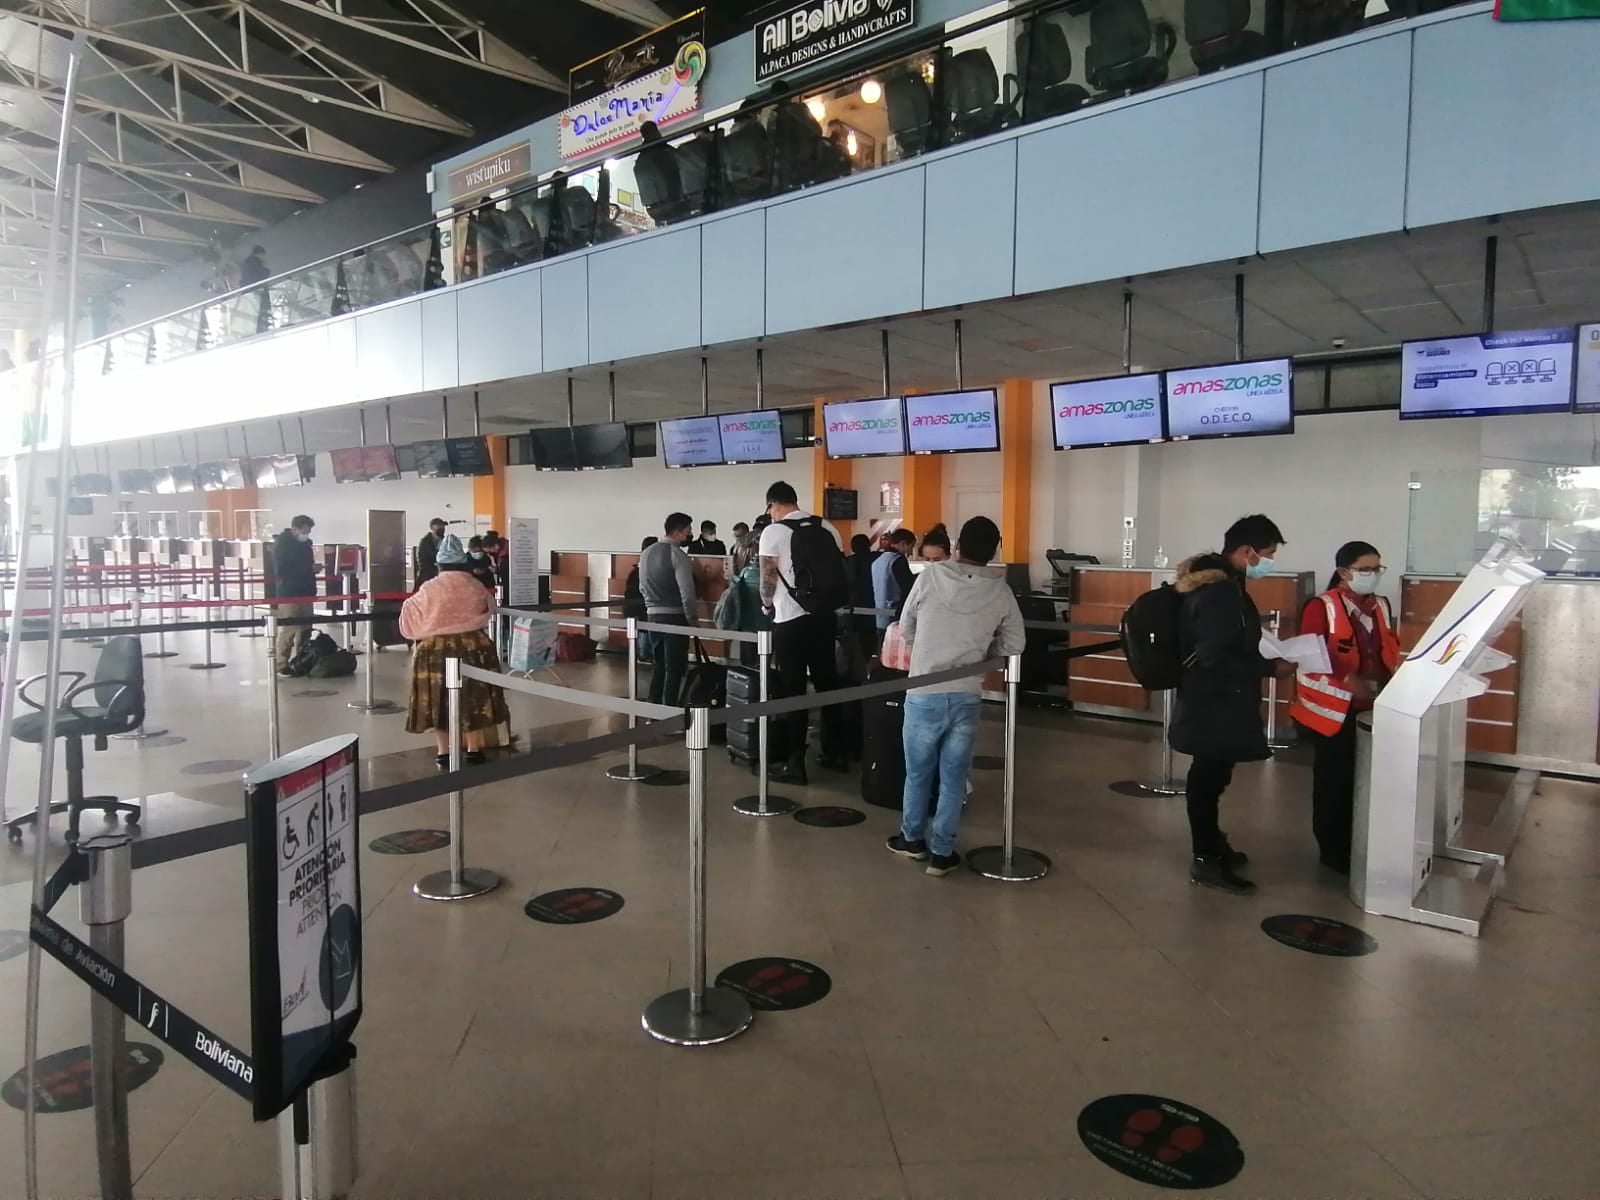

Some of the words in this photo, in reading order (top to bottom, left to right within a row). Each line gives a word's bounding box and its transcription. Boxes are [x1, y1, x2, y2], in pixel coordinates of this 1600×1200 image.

[763, 18, 787, 53] All
[791, 0, 868, 42] Bolivia
[759, 54, 790, 77] ALPACA
[791, 39, 828, 63] DESIGNS
[829, 37, 836, 49] &
[838, 7, 907, 45] HANDYCRAFTS
[1173, 373, 1283, 396] amaszonas
[912, 411, 991, 427] amaszonas
[1059, 398, 1155, 419] amaszonas
[829, 417, 897, 433] amaszonas
[194, 1031, 254, 1084] Boliviana
